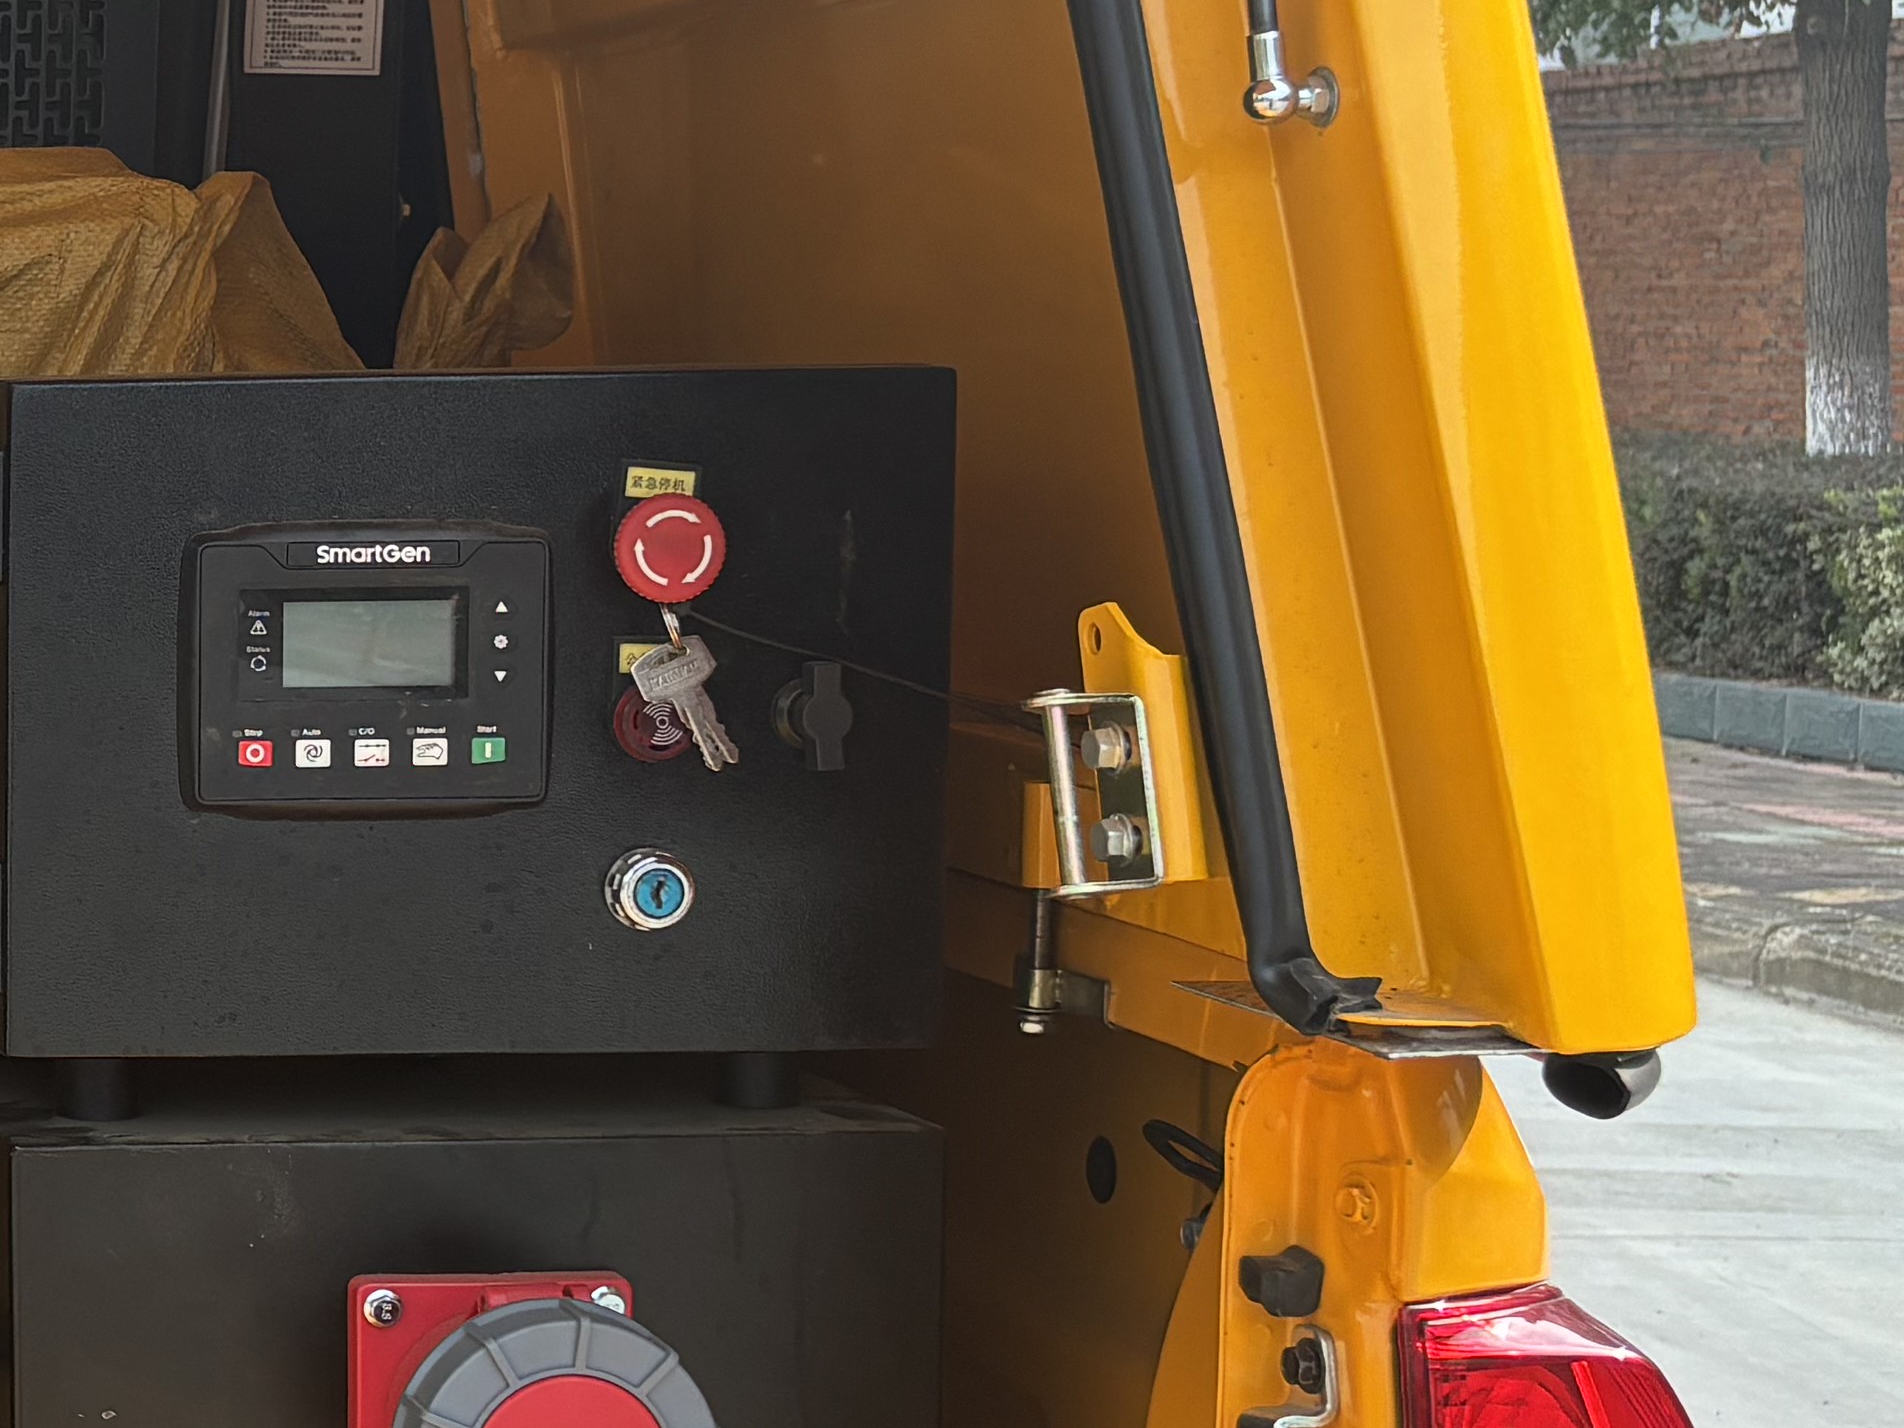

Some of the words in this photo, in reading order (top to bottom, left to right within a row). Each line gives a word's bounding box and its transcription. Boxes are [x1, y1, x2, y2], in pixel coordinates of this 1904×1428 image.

[630, 475, 686, 492] 紧急停机
[316, 544, 431, 564] SmartGen
[248, 609, 270, 617] Alarm
[244, 729, 264, 738] Stop
[302, 728, 321, 737] Auto
[358, 727, 376, 736] C/O
[416, 726, 446, 735] Manual
[477, 726, 497, 734] Start
